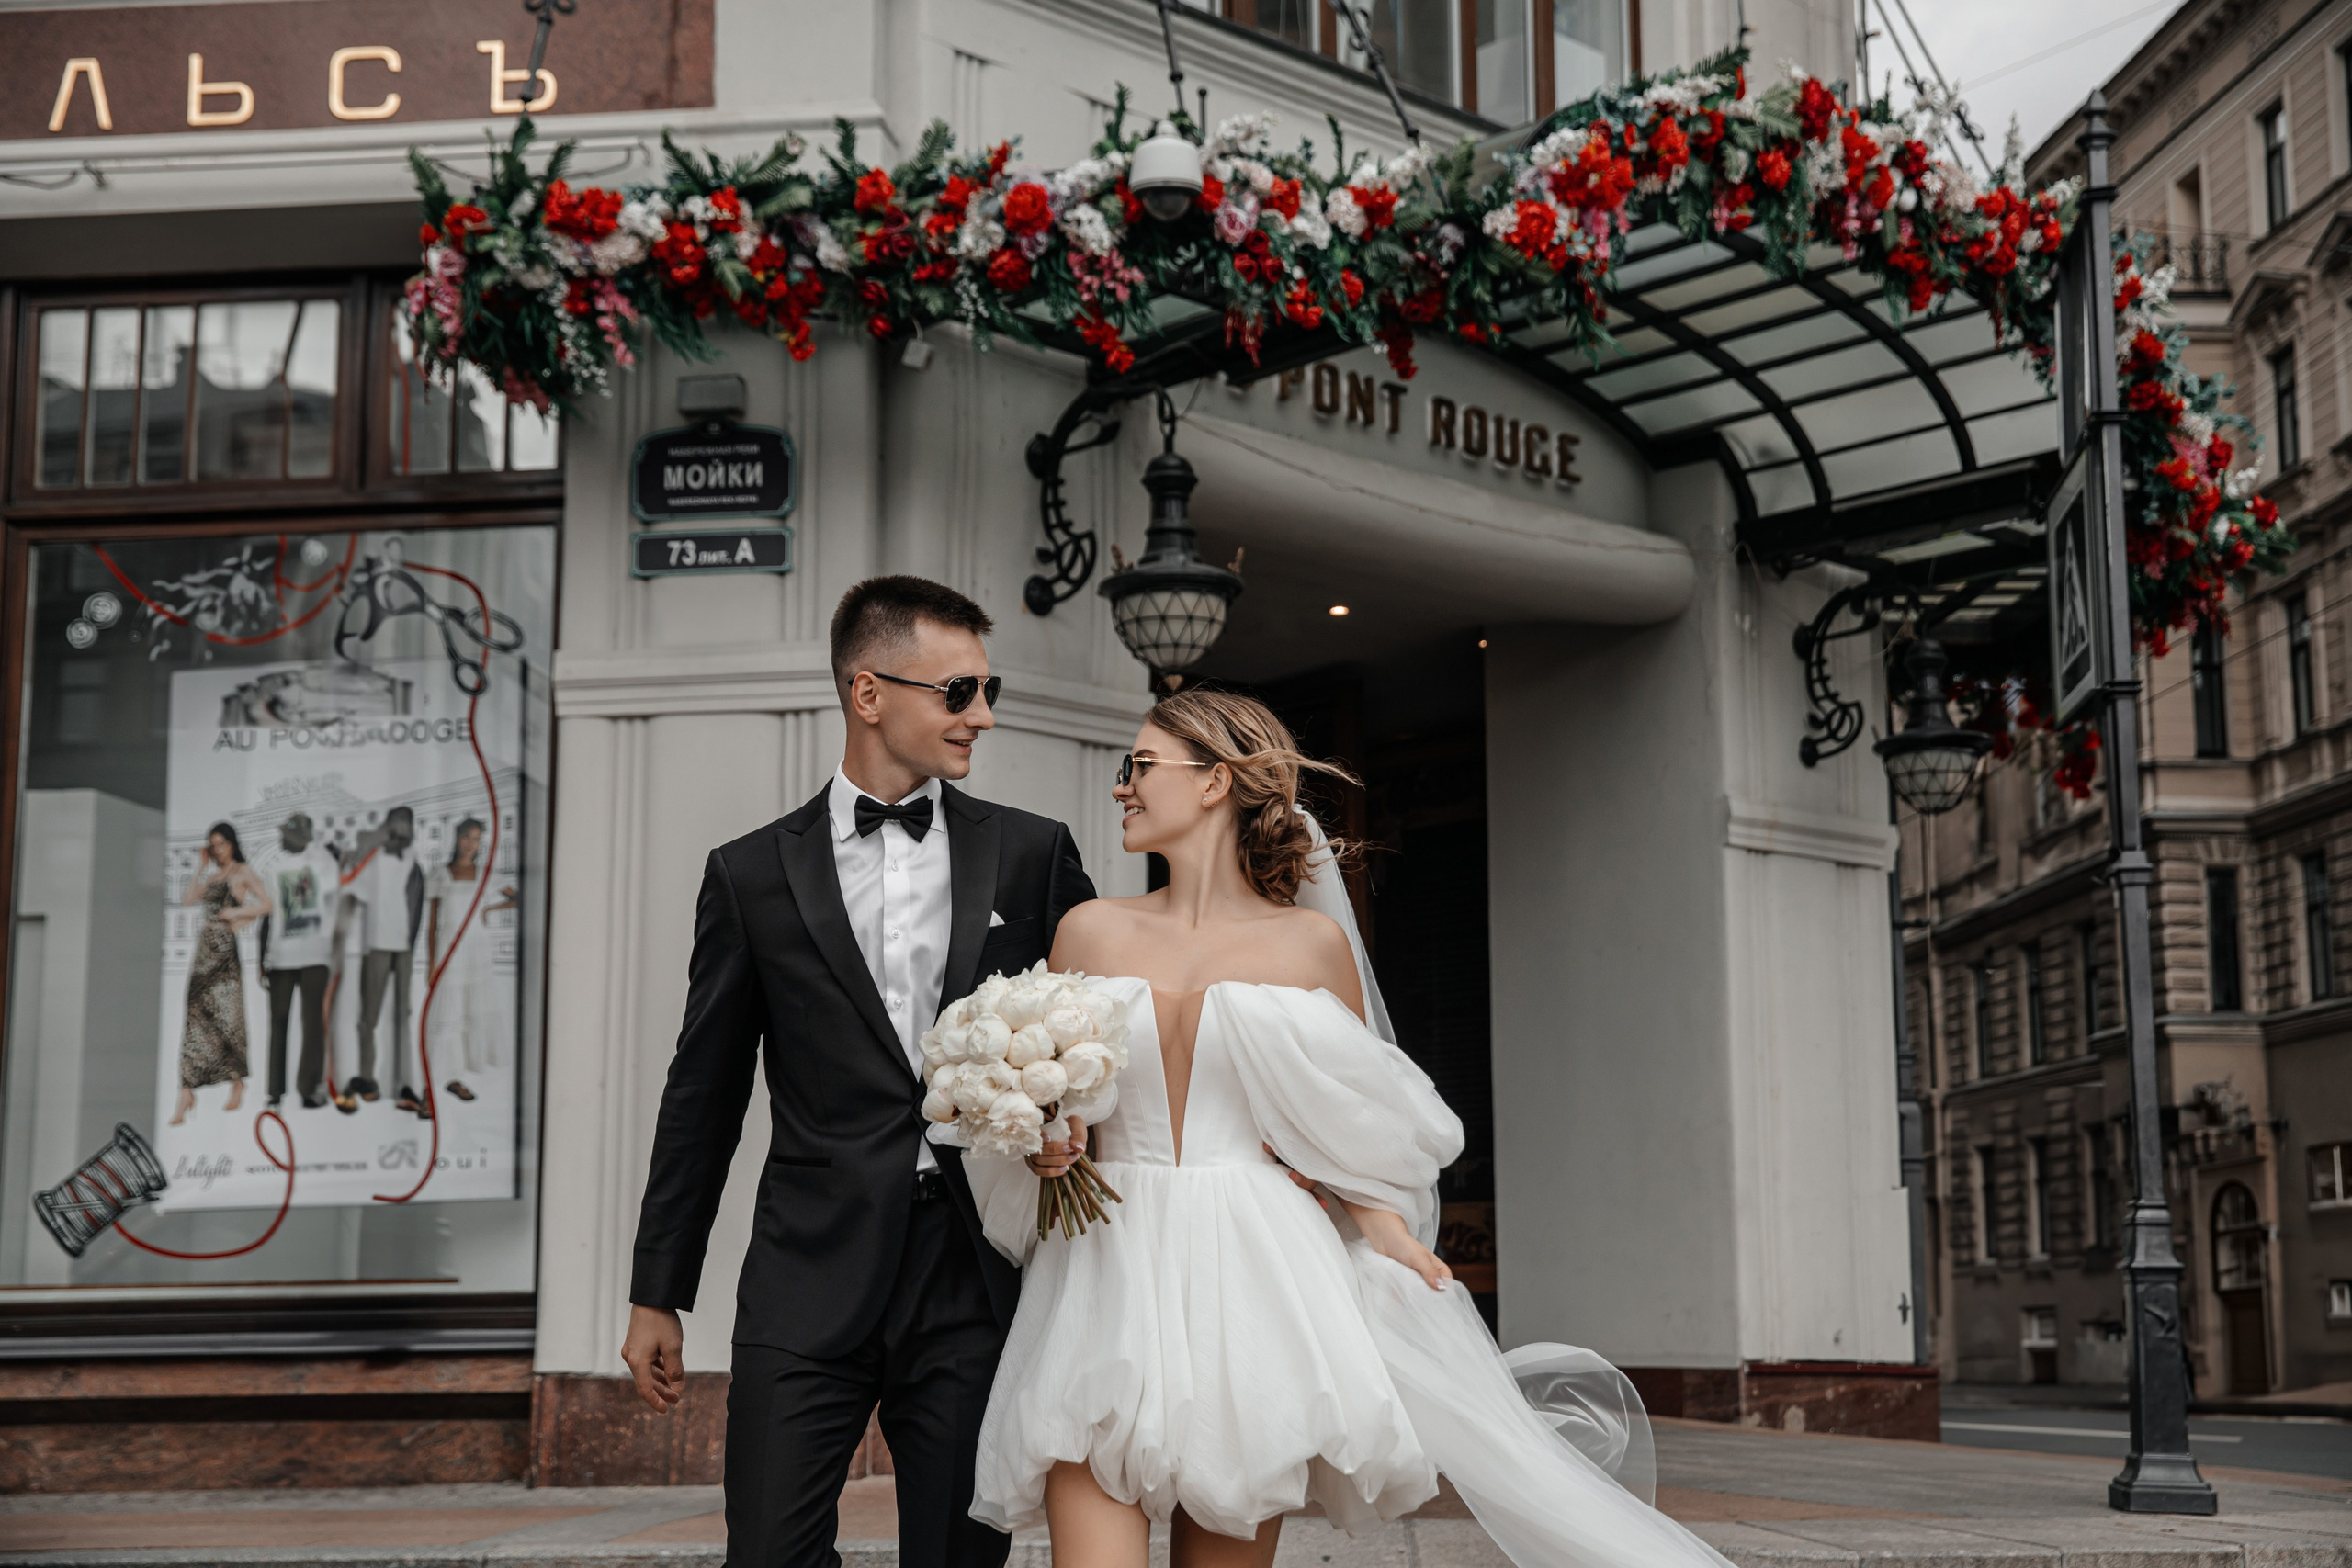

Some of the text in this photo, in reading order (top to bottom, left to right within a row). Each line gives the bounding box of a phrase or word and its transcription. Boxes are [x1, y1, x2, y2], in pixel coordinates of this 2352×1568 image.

[1278, 362, 1583, 484] PONT ROUGE
[662, 458, 764, 491] МОЙКИ
[666, 539, 697, 567] 73
[212, 728, 258, 753] AU
